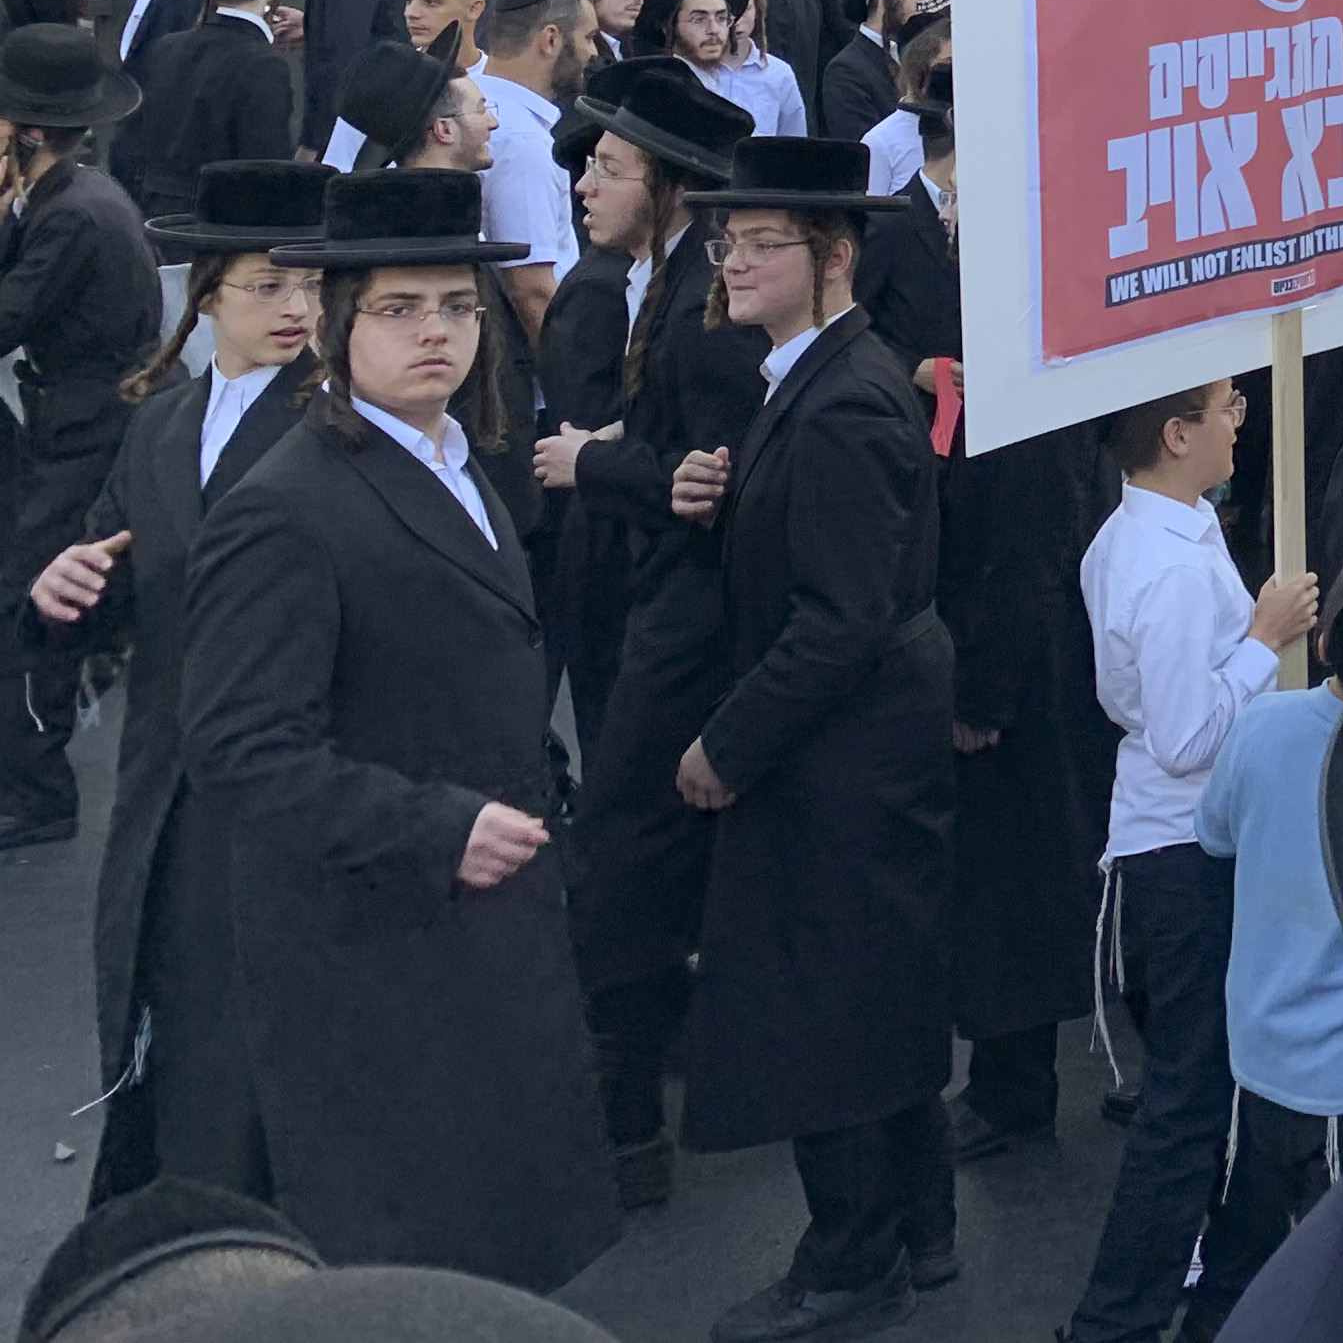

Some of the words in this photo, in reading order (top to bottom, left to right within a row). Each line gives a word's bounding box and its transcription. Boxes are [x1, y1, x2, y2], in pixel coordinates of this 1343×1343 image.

[1107, 111, 1258, 260] אויב
[1110, 278, 1140, 303] WE
[1142, 269, 1189, 297] WILL
[1191, 257, 1228, 283] NOT
[1230, 238, 1298, 273] ENLIST
